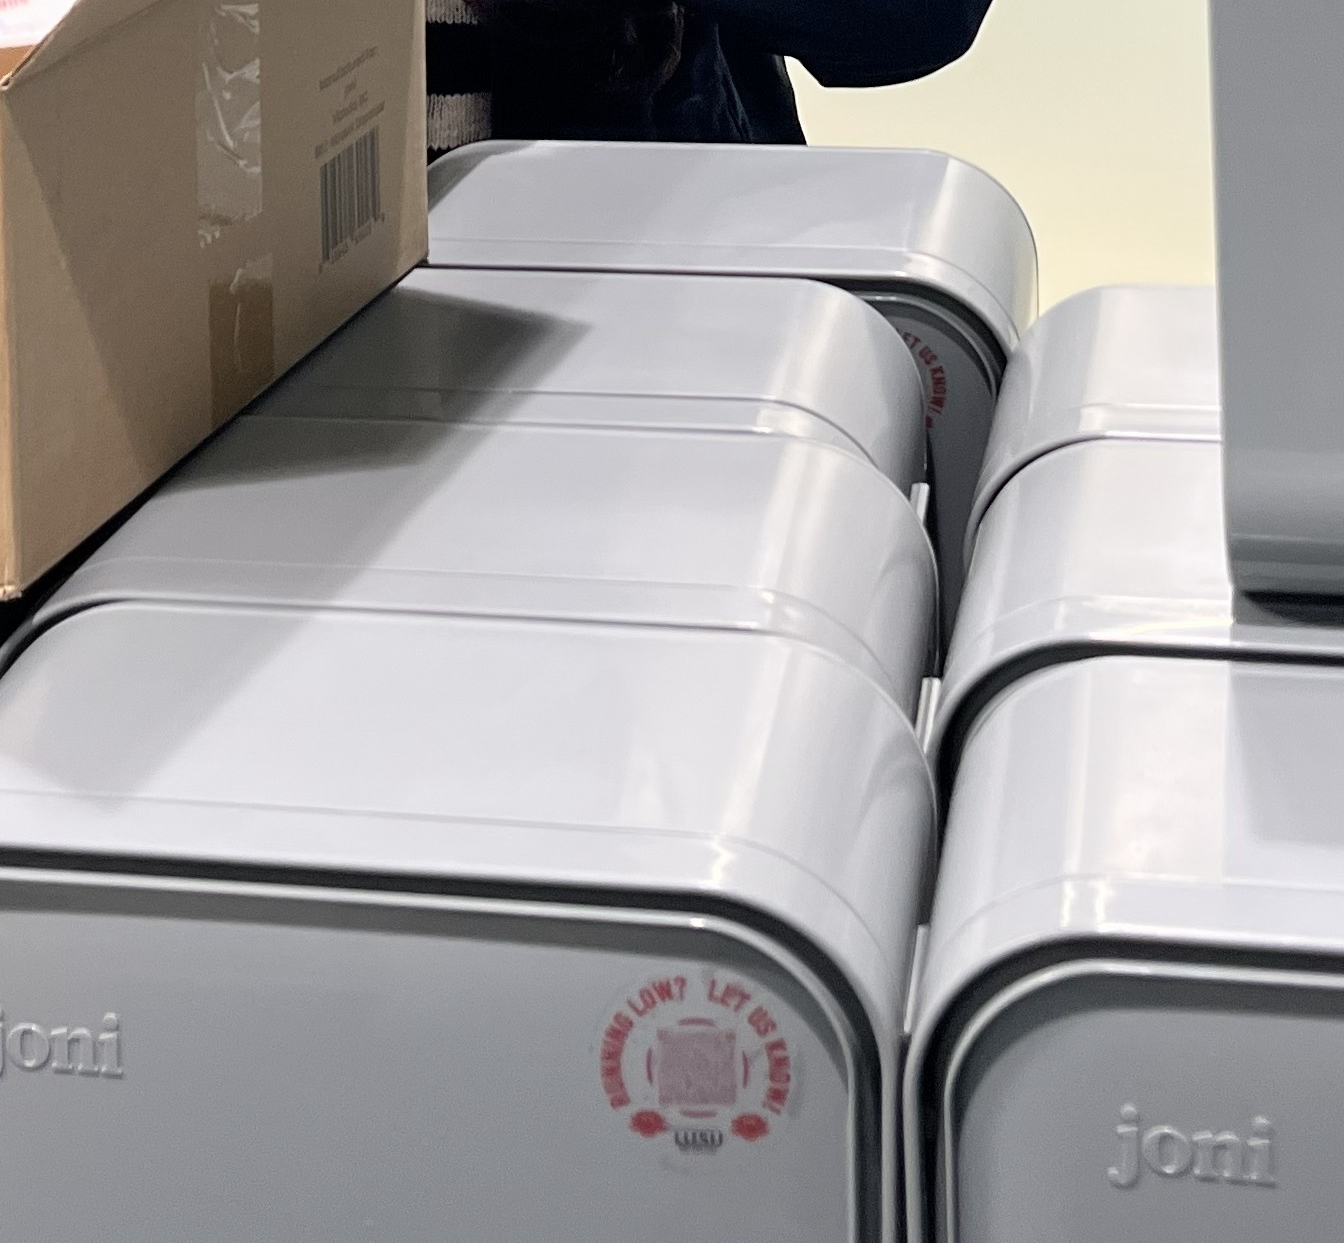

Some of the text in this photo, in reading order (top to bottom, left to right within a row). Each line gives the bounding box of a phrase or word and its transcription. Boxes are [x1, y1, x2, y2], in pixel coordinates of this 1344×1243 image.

[601, 974, 687, 1109] RUNNING LOW?
[708, 978, 791, 1115] LET US KNOW!
[1107, 1102, 1278, 1189] joni
